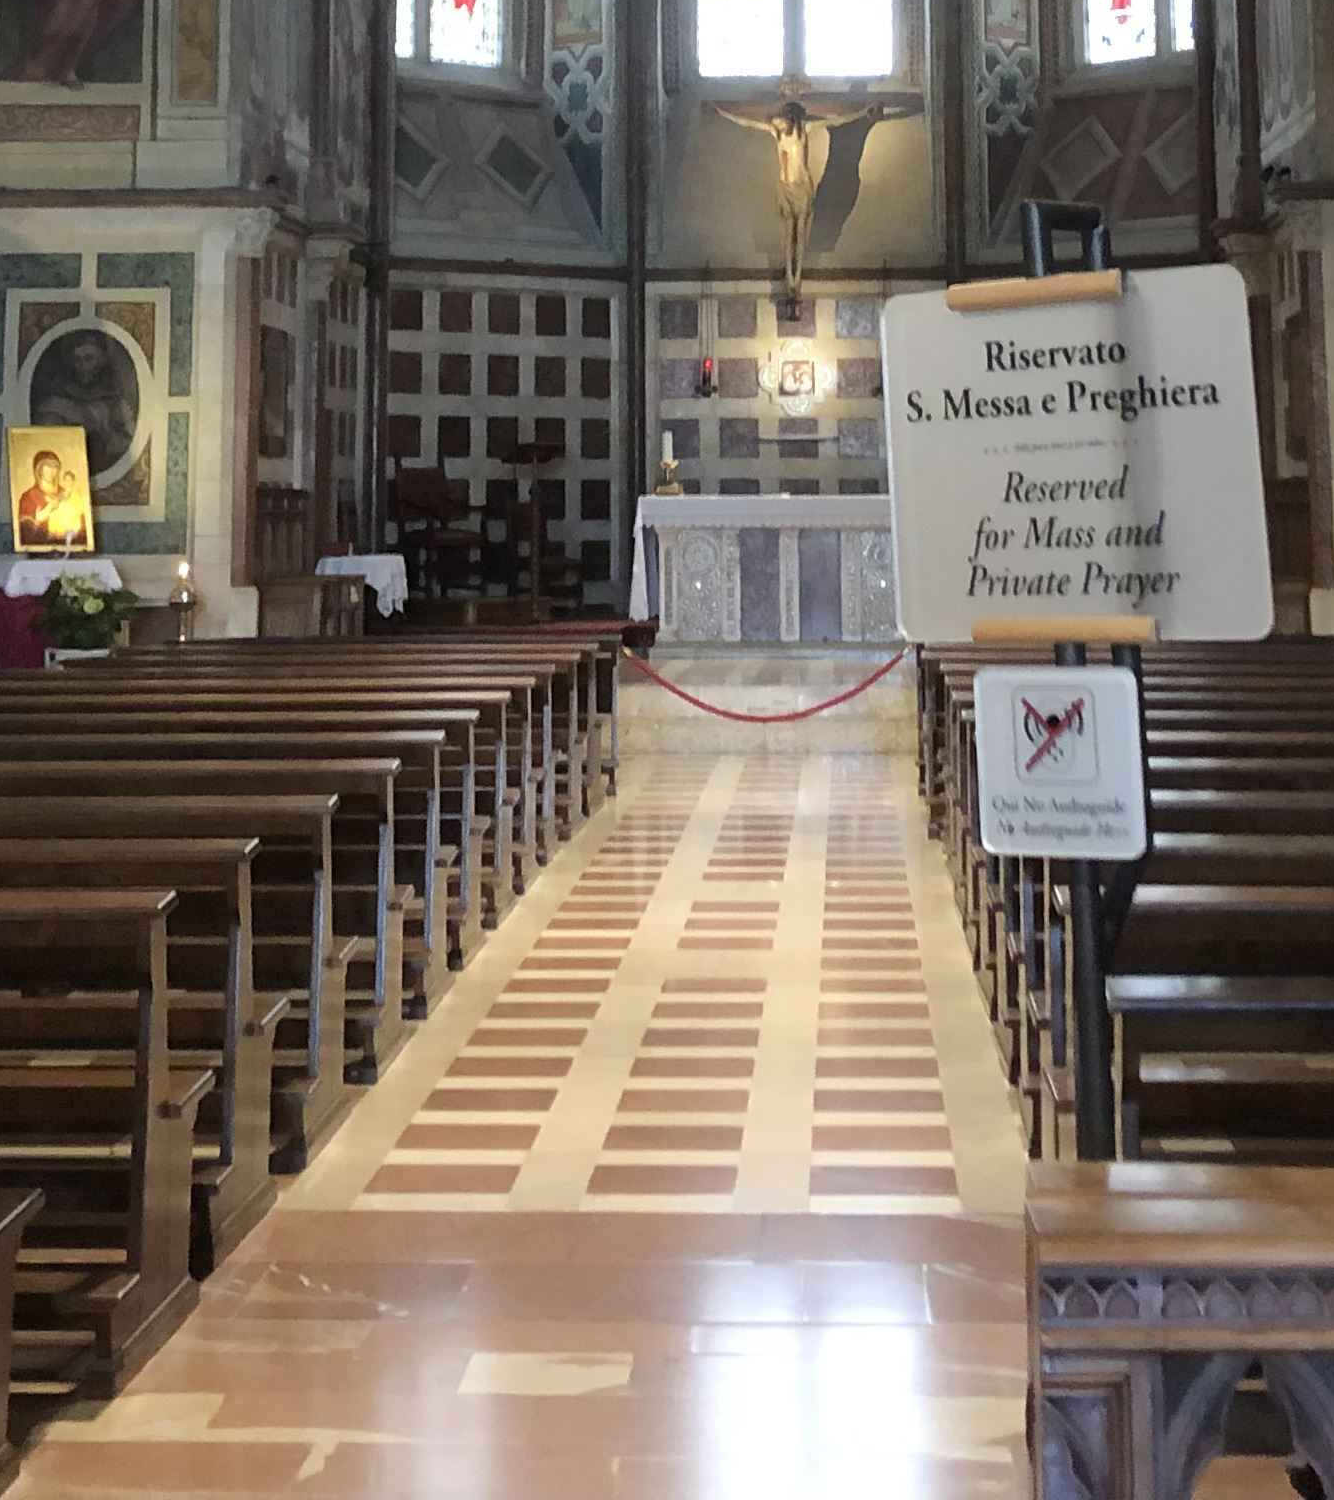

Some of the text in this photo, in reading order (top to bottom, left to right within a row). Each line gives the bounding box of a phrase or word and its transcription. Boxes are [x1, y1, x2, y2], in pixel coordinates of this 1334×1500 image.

[985, 339, 1127, 372] Riservato
[906, 376, 1220, 423] S. Messa e Preghiera
[1003, 464, 1129, 504] Reserved
[968, 509, 1165, 562] for Mass and
[966, 561, 1180, 607] Private Prayer
